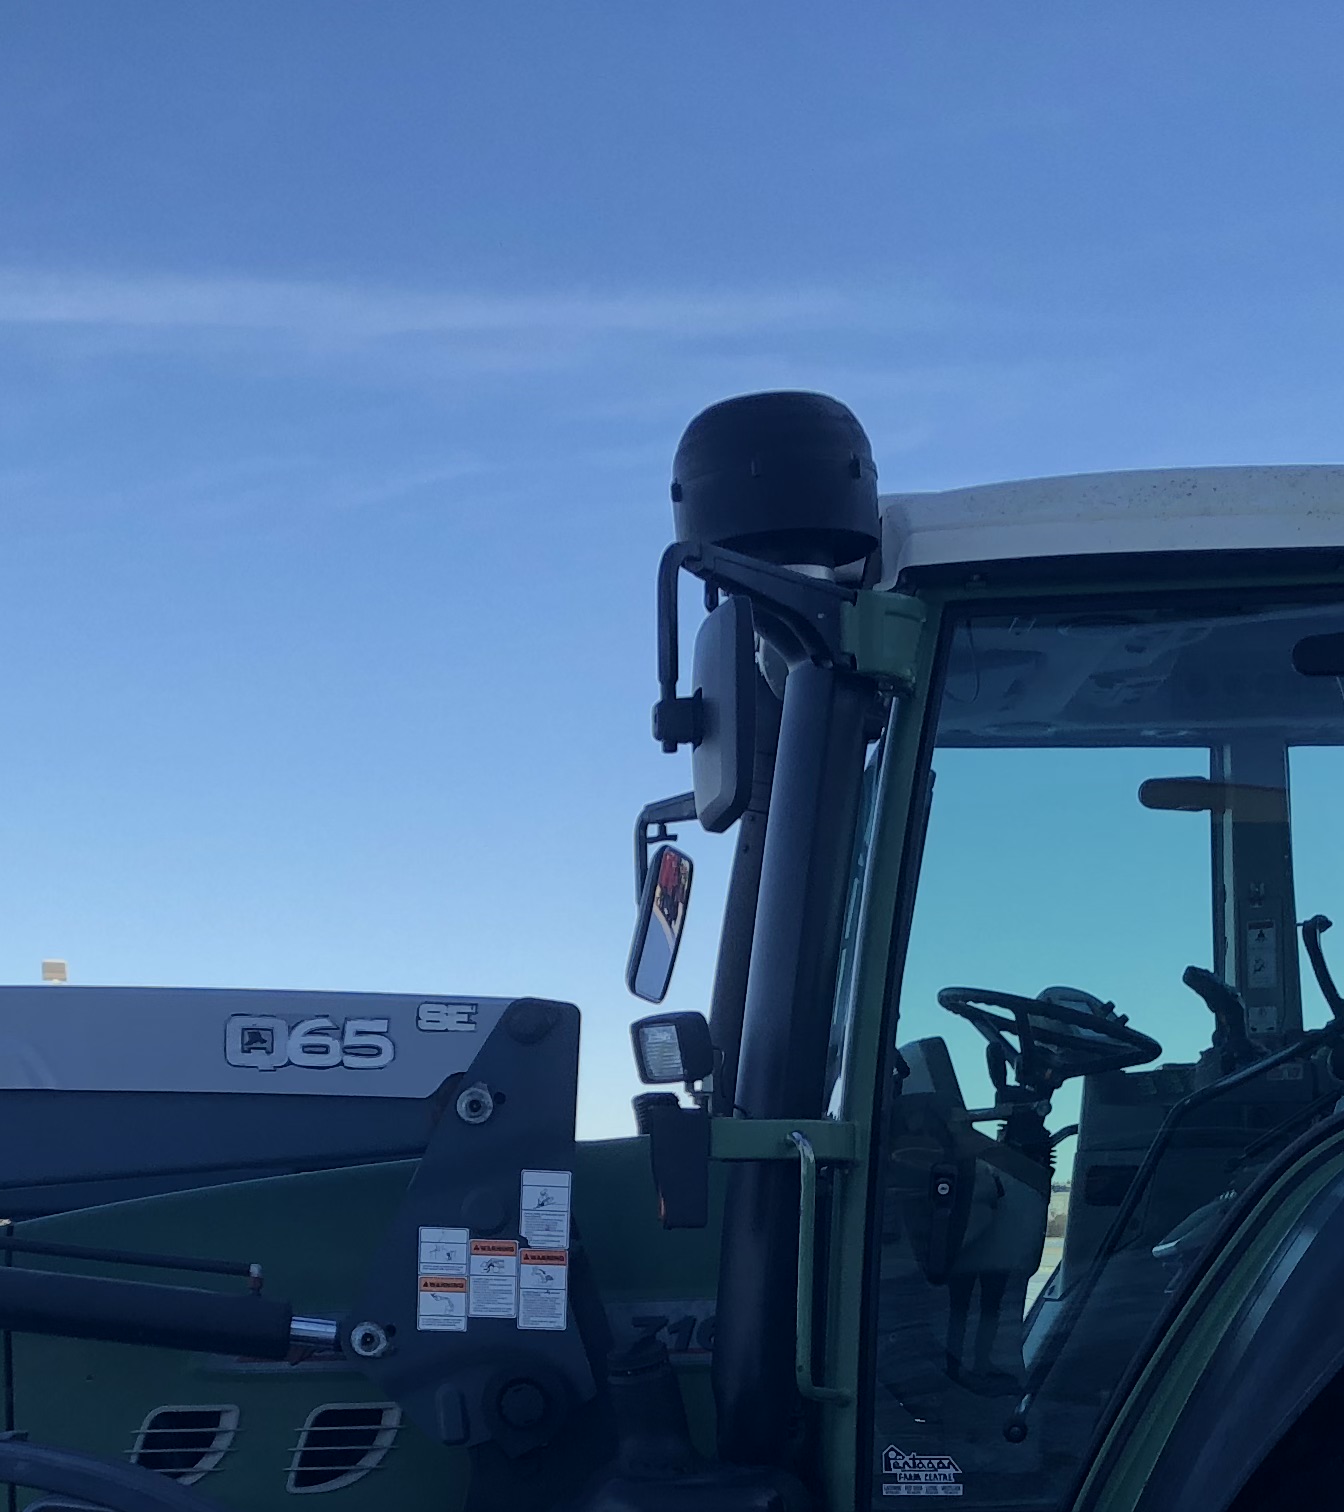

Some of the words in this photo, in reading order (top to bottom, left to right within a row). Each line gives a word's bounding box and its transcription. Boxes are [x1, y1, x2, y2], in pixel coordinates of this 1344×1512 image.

[416, 1001, 478, 1032] SE
[224, 1013, 396, 1072] Q65
[480, 1245, 515, 1253] WARNING
[529, 1254, 565, 1262] WARNING
[429, 1281, 464, 1289] WARNING
[884, 1446, 960, 1473] Pentagon
